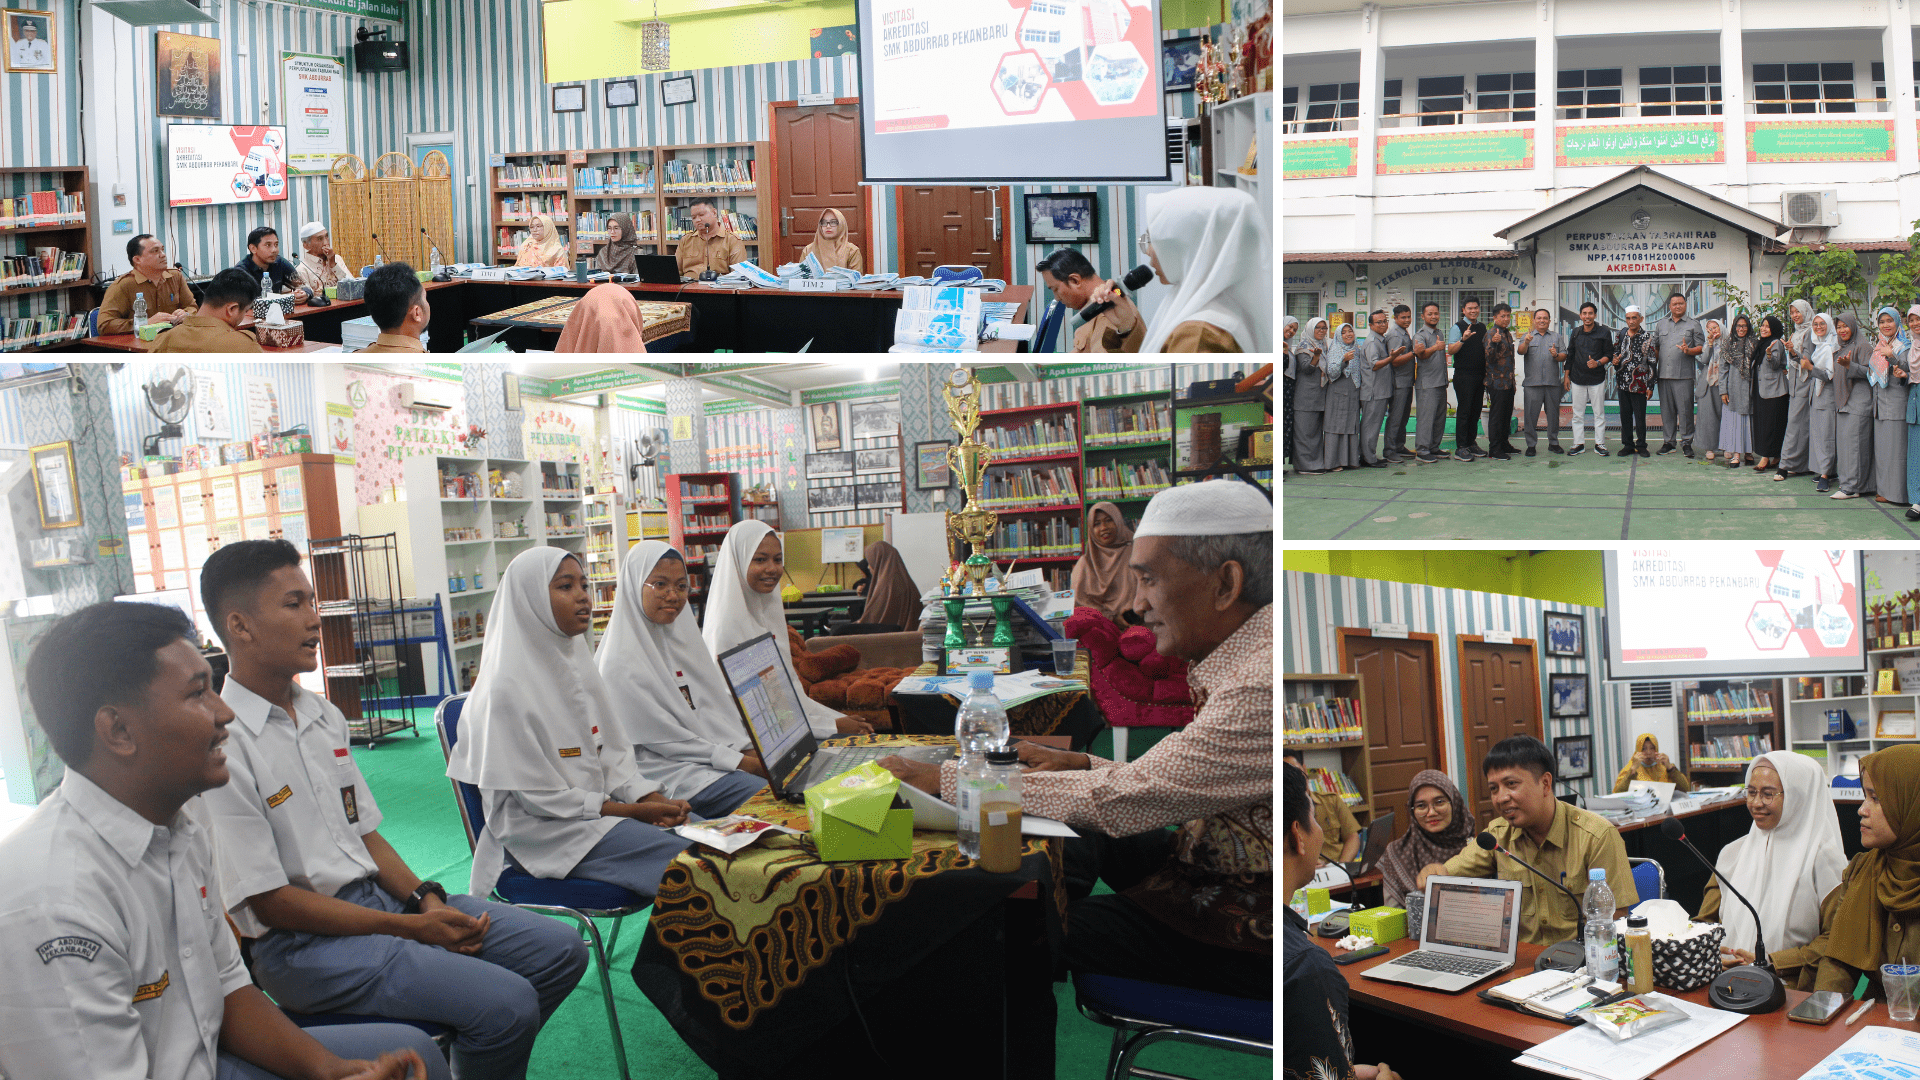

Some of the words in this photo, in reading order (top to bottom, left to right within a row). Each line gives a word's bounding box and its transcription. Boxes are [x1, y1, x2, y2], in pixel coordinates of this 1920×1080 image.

[357, 1, 380, 12] jalan
[381, 3, 399, 16] ilahi
[882, 7, 915, 26] VISITASI
[883, 20, 929, 41] AKREDITASI
[883, 42, 901, 57] SMK
[903, 33, 949, 54] ABDURRAB
[952, 23, 1008, 46] PEKANBARU
[176, 146, 196, 154] VISITASI
[1566, 232, 1646, 241] PERPUSTAKAAN
[1649, 231, 1693, 240] TABRANI
[1695, 231, 1717, 239] RAB
[1569, 243, 1590, 251] SMK
[1592, 243, 1648, 251] ABDURRAB
[1651, 242, 1714, 250] PEKANBARU
[1669, 263, 1676, 271] A
[1283, 276, 1315, 284] CORNER
[1374, 262, 1433, 290] TEKNOLOGI
[1440, 260, 1528, 291] LABORATORIUM
[1432, 276, 1475, 285] MEDIK
[1049, 368, 1066, 376] Apa
[1067, 365, 1091, 374] tanda
[1632, 560, 1686, 572] AKREDITASI
[1633, 575, 1655, 588] SMK
[1659, 575, 1707, 588] ABDURRAB
[1710, 576, 1760, 588] PEKANBARU
[40, 944, 54, 955] SMK
[58, 939, 97, 952] ABDURRAB
[45, 946, 92, 958] PEKANBARU
